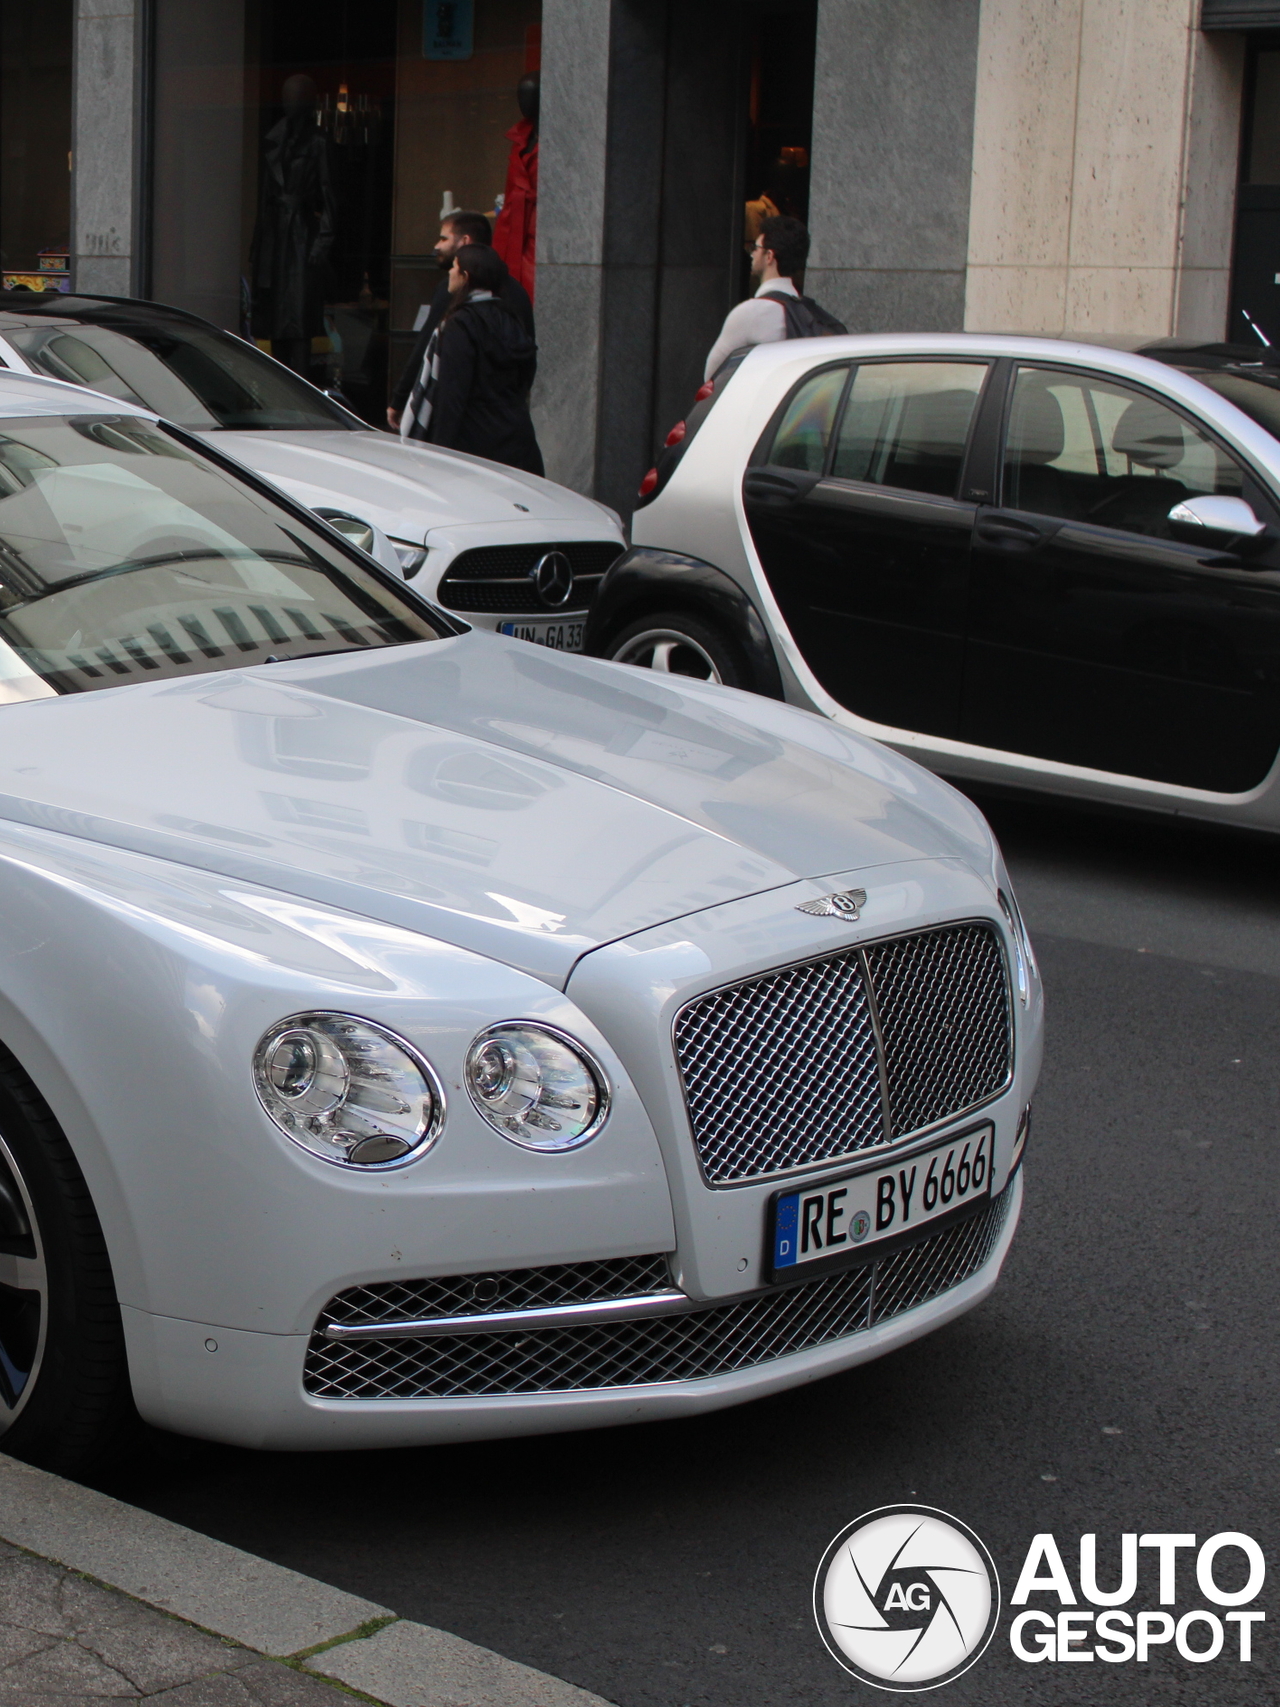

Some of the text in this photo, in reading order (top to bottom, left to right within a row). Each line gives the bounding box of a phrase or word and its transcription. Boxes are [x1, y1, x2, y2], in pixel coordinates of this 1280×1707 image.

[545, 625, 564, 649] GA
[800, 1135, 987, 1254] RE BY 6666
[780, 1239, 790, 1257] D
